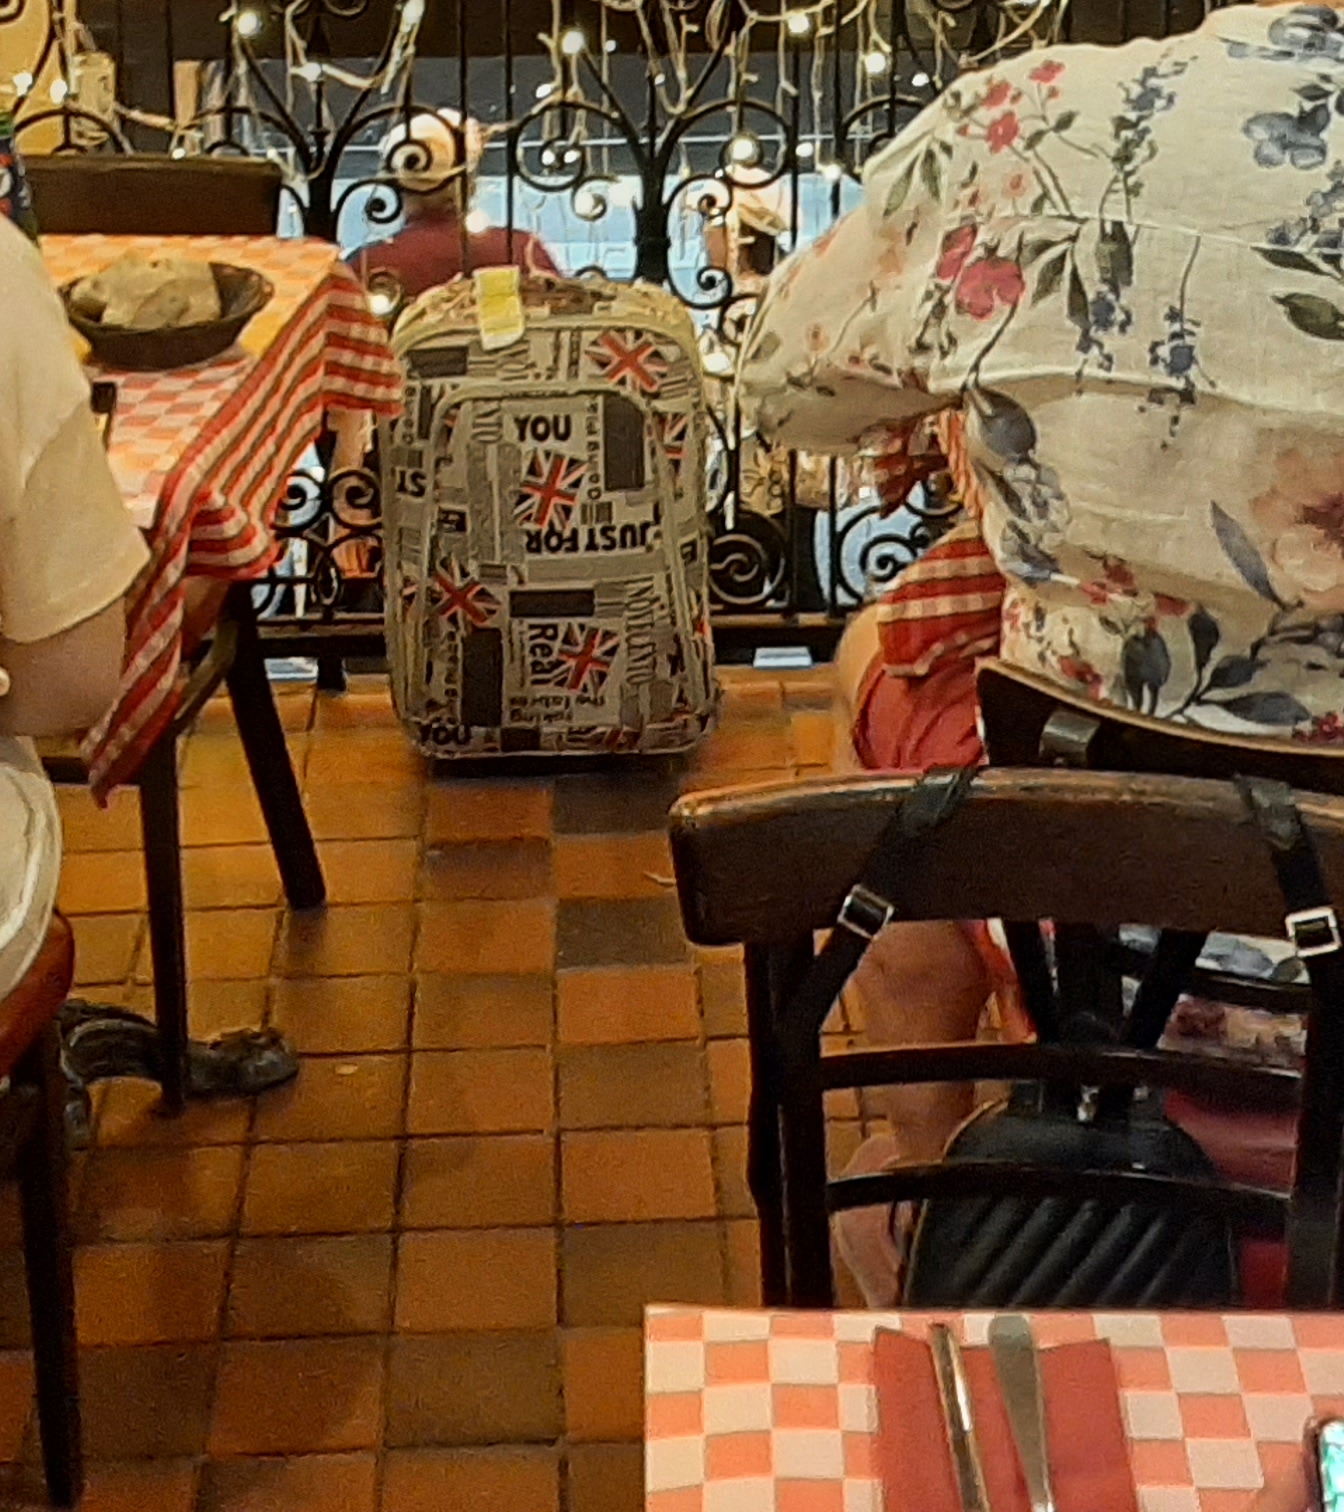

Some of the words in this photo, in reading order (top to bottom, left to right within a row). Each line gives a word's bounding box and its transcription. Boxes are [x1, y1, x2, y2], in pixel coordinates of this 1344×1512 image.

[514, 414, 571, 441] YOU
[525, 526, 579, 554] FOR
[584, 521, 651, 552] JUST
